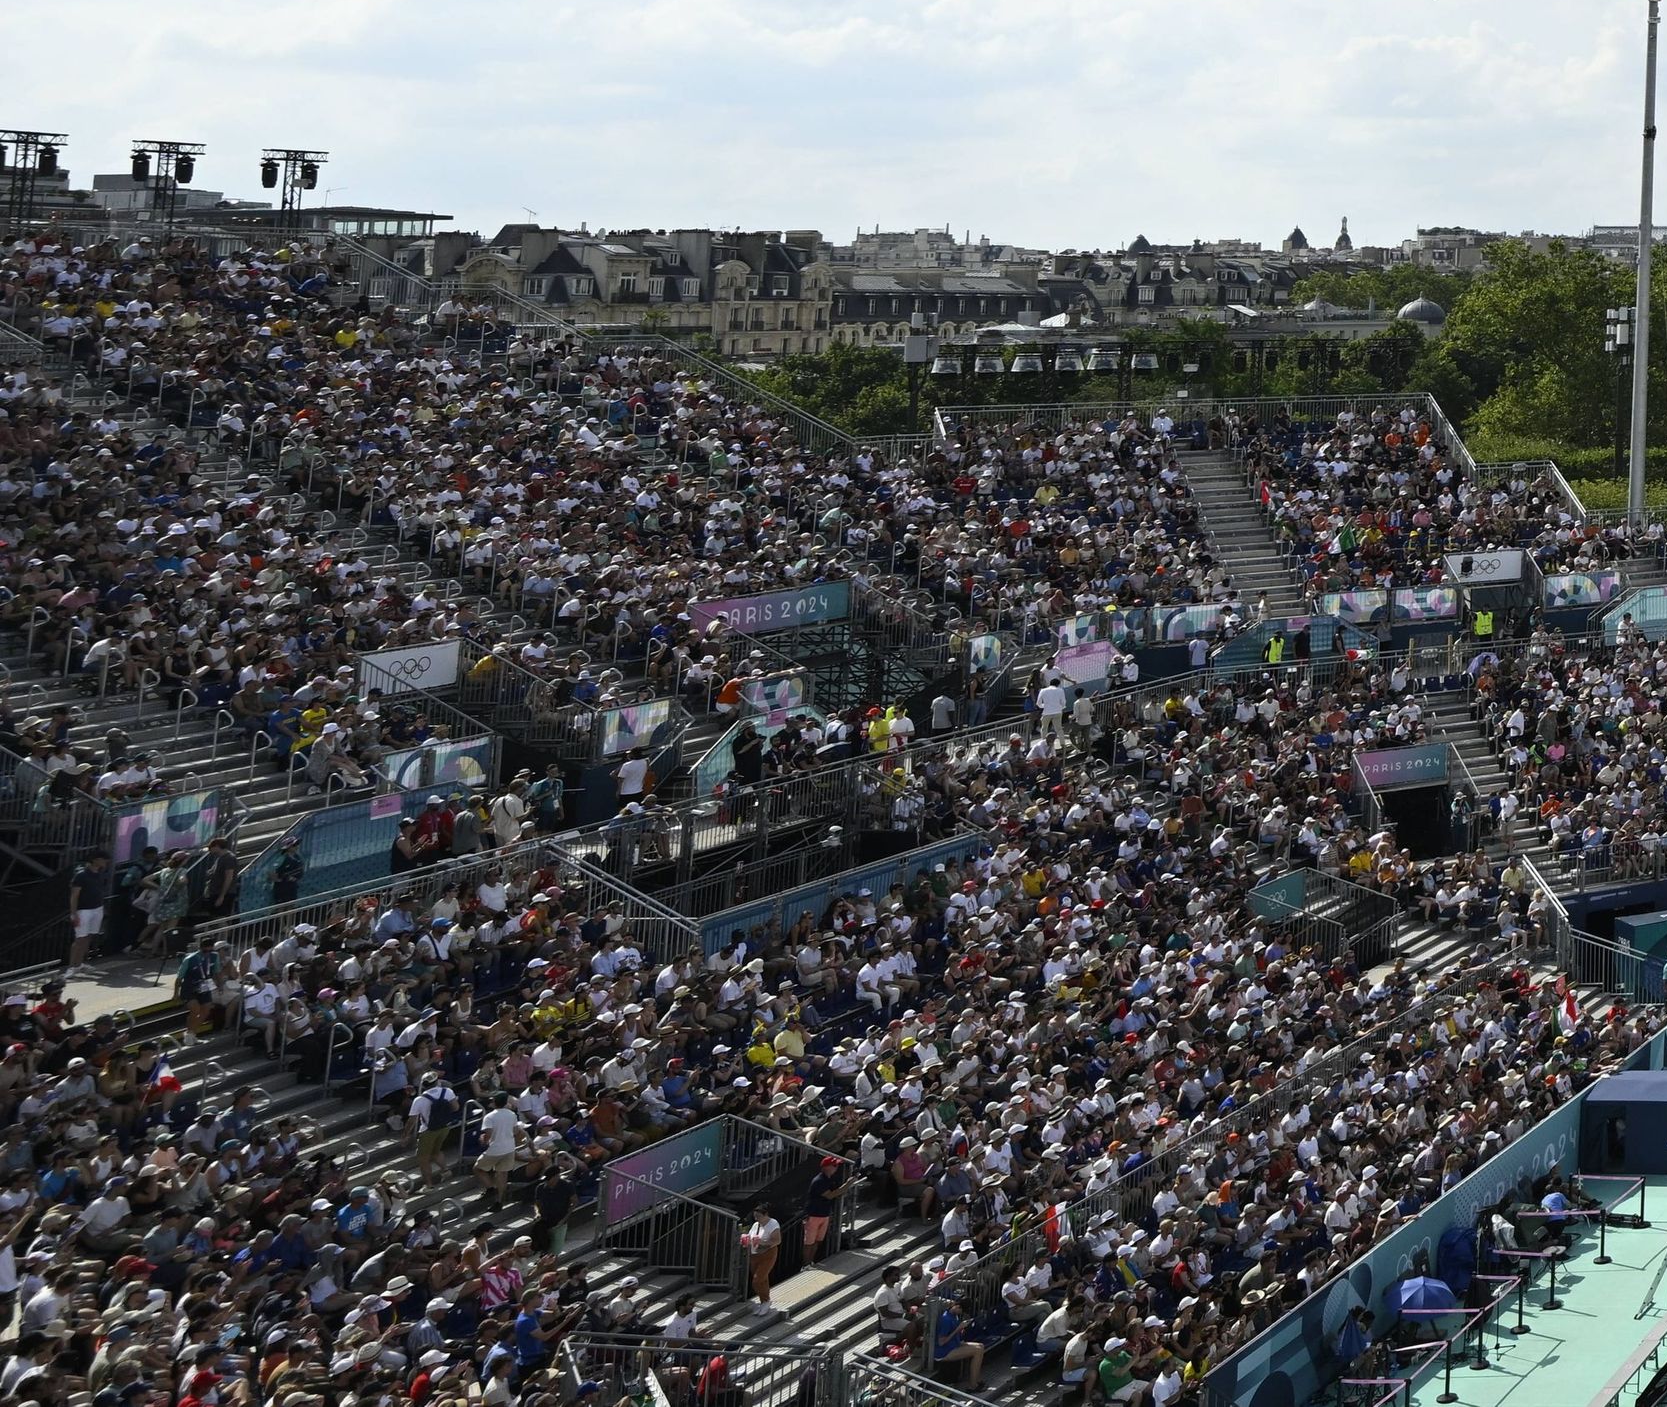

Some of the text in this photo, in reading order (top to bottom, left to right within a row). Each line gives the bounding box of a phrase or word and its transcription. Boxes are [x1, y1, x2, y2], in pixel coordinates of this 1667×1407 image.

[781, 595, 828, 618] 2024
[1406, 758, 1440, 770] 2024
[670, 1147, 712, 1174] 2024
